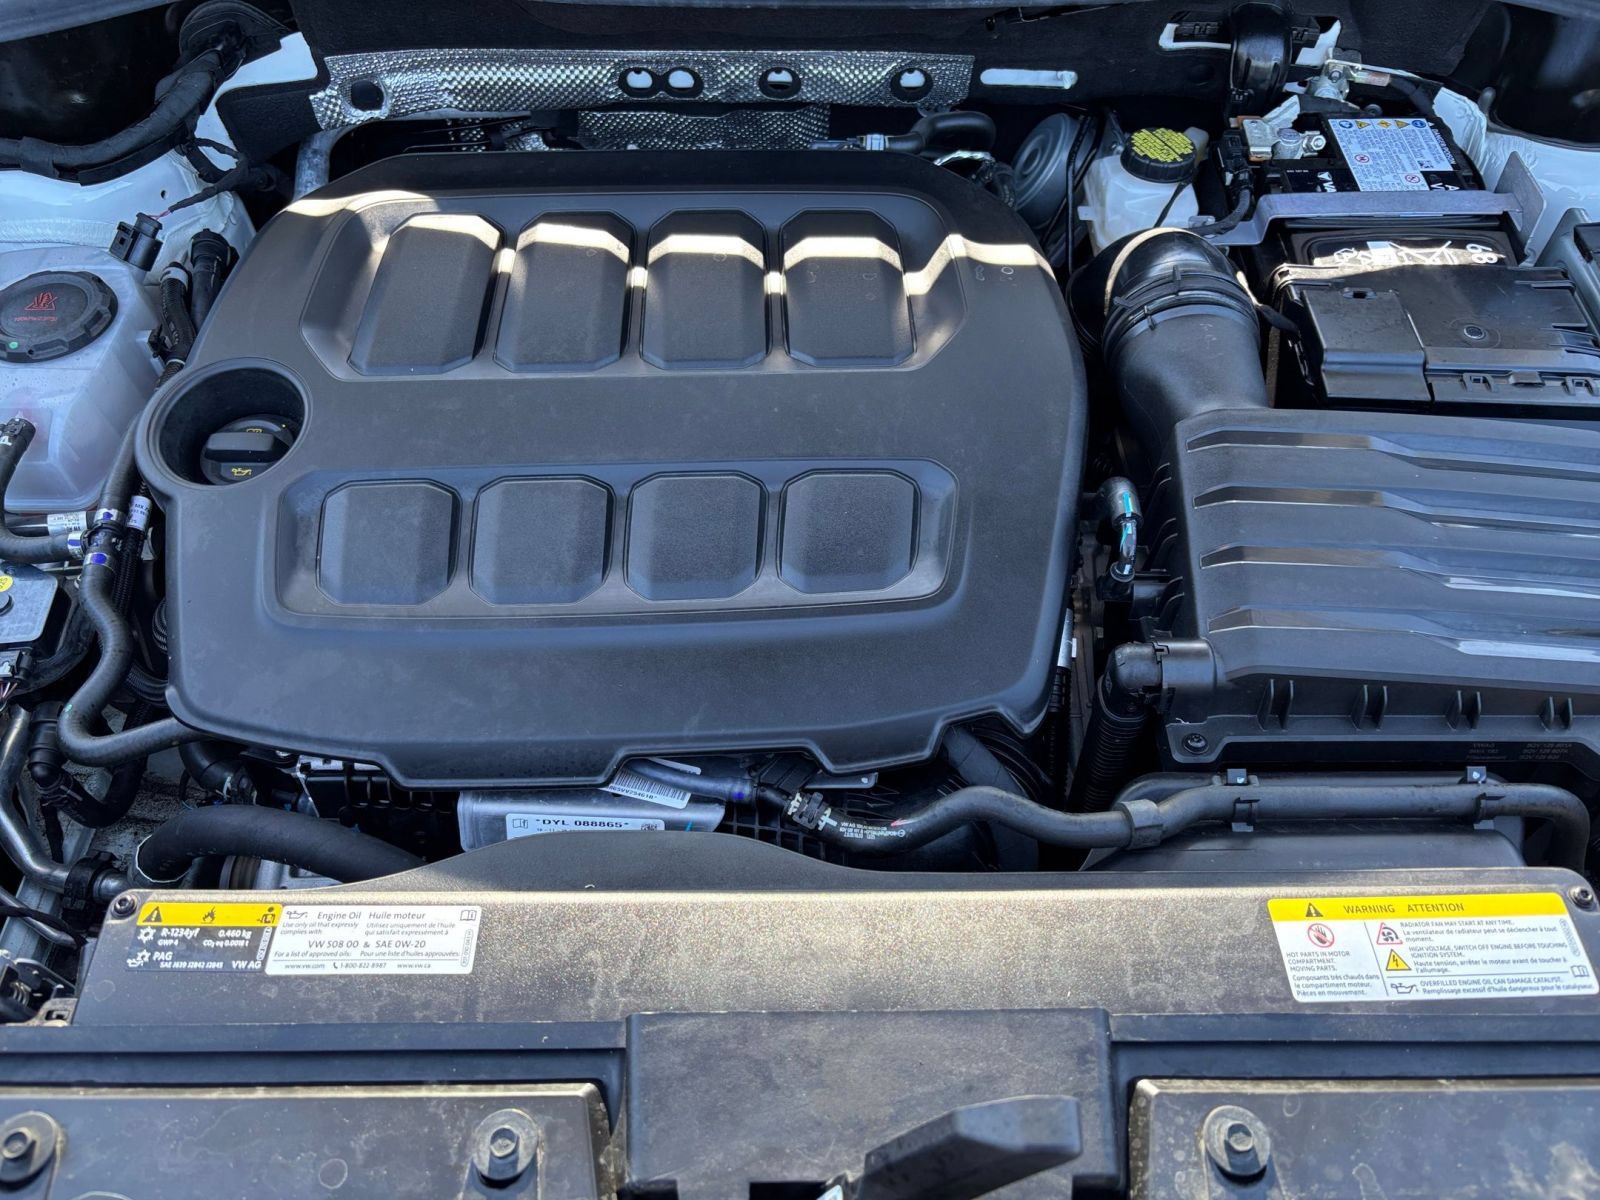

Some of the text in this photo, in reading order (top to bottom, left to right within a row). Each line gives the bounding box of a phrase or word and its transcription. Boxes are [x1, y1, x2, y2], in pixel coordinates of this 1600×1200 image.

[1344, 903, 1464, 914] WARNING ATTENTION
[317, 912, 346, 920] Engine
[160, 928, 200, 940] R-1234yf
[242, 930, 252, 939] kg
[153, 952, 173, 960] PAG
[249, 961, 261, 969] AG
